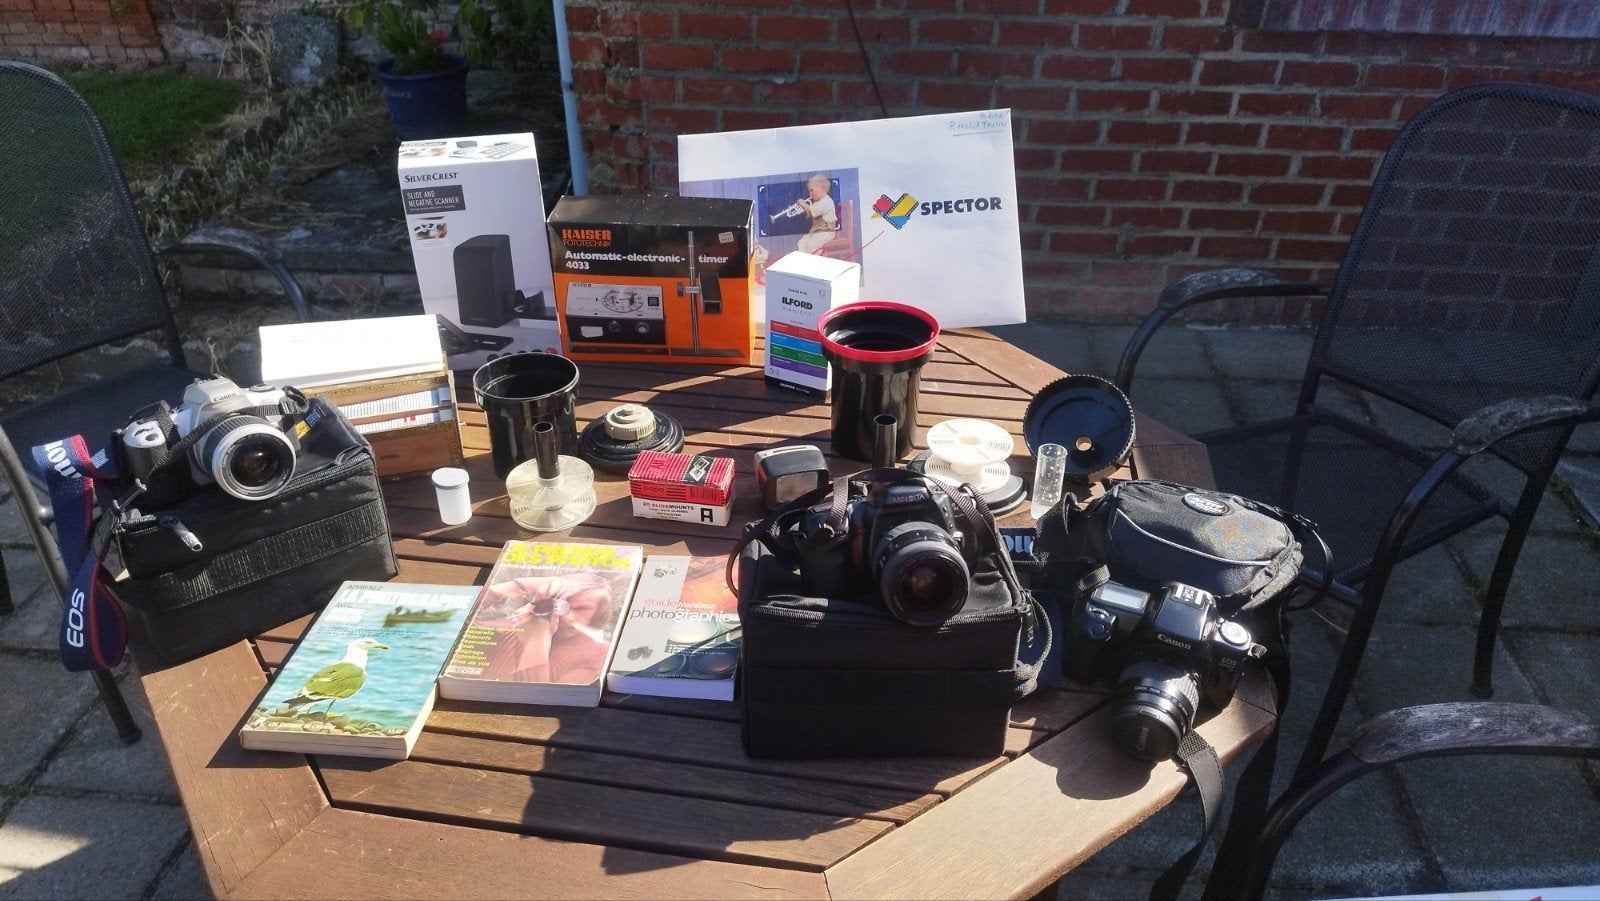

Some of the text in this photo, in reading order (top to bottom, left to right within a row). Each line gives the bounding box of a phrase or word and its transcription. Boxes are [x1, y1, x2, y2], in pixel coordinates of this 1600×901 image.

[406, 190, 436, 200] SLIDE AND
[408, 196, 460, 207] NEGATIVE SCANNER
[921, 197, 1003, 216] SPECTOR
[565, 260, 590, 270] 4033
[698, 254, 729, 263] timer
[782, 296, 813, 310] ILFORD
[891, 491, 926, 504] MINOLTA
[700, 507, 713, 523] A
[644, 598, 677, 608] guide
[677, 601, 717, 610] Marabout
[66, 587, 85, 648] EOS
[629, 606, 733, 623] photographie
[1157, 633, 1192, 651] Canon
